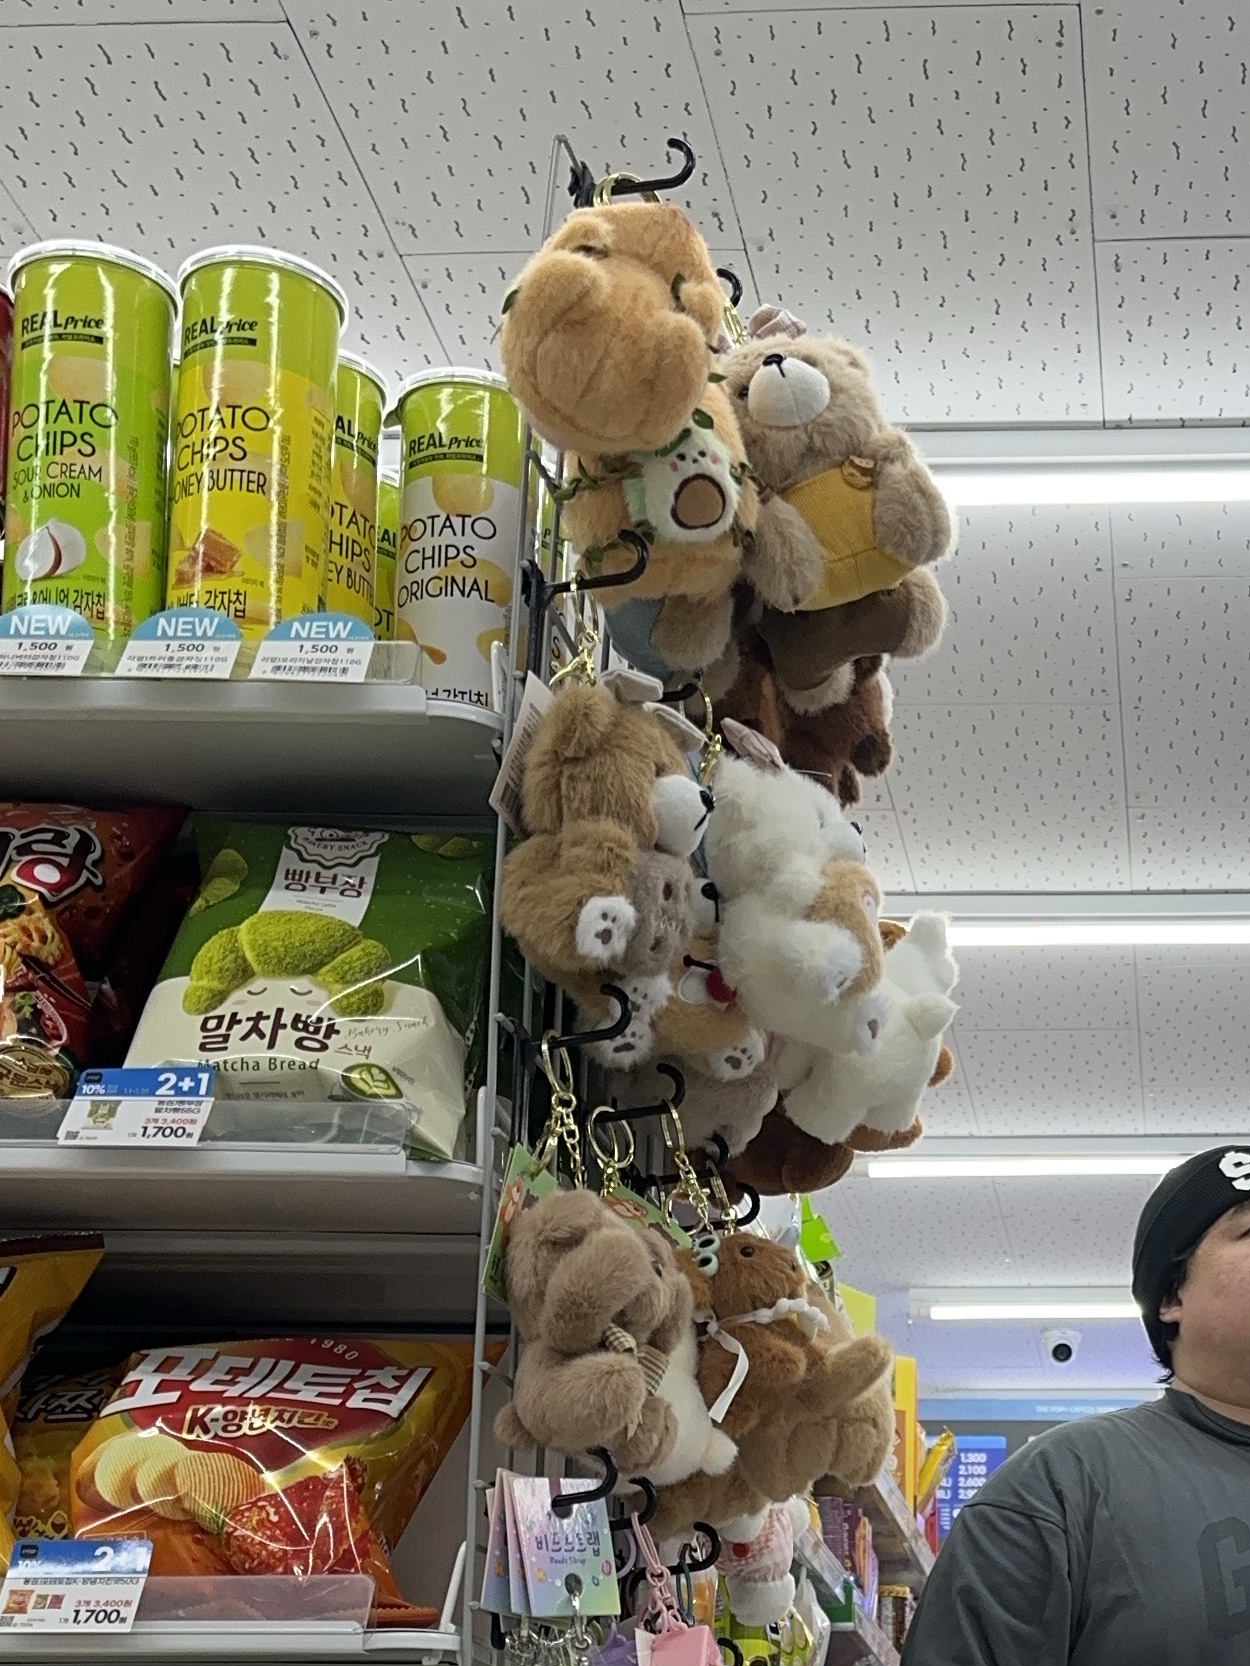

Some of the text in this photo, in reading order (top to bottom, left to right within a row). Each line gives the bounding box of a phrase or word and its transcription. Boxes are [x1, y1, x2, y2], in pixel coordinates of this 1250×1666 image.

[21, 310, 104, 338] REAL Price
[184, 316, 217, 347] REAL
[12, 399, 119, 437] POTATO
[16, 430, 96, 462] CHIPS
[177, 436, 248, 472] CHIPS
[408, 432, 484, 458] REAL Price
[46, 461, 102, 483] CREAM
[31, 481, 81, 502] ONION
[171, 468, 268, 505] ONEY BUTTER
[401, 513, 497, 543] POTATO
[329, 531, 371, 573] HIPS
[404, 544, 478, 574] CHIPS
[397, 575, 496, 609] ORIGINAL
[9, 614, 73, 636] NEW
[156, 616, 220, 638] NEW
[290, 620, 353, 640] NEW
[17, 641, 58, 652] 1,500
[164, 643, 206, 654] 1,500
[298, 644, 339, 655] 1,500
[283, 867, 368, 899] 빵부장
[198, 1007, 341, 1054] 말차빵
[197, 1057, 321, 1072] Matcha Bread
[81, 1084, 105, 1095] 10%
[154, 1072, 210, 1096] 2+1
[100, 1348, 431, 1420] 포테토칩
[93, 1545, 148, 1573] 2+1
